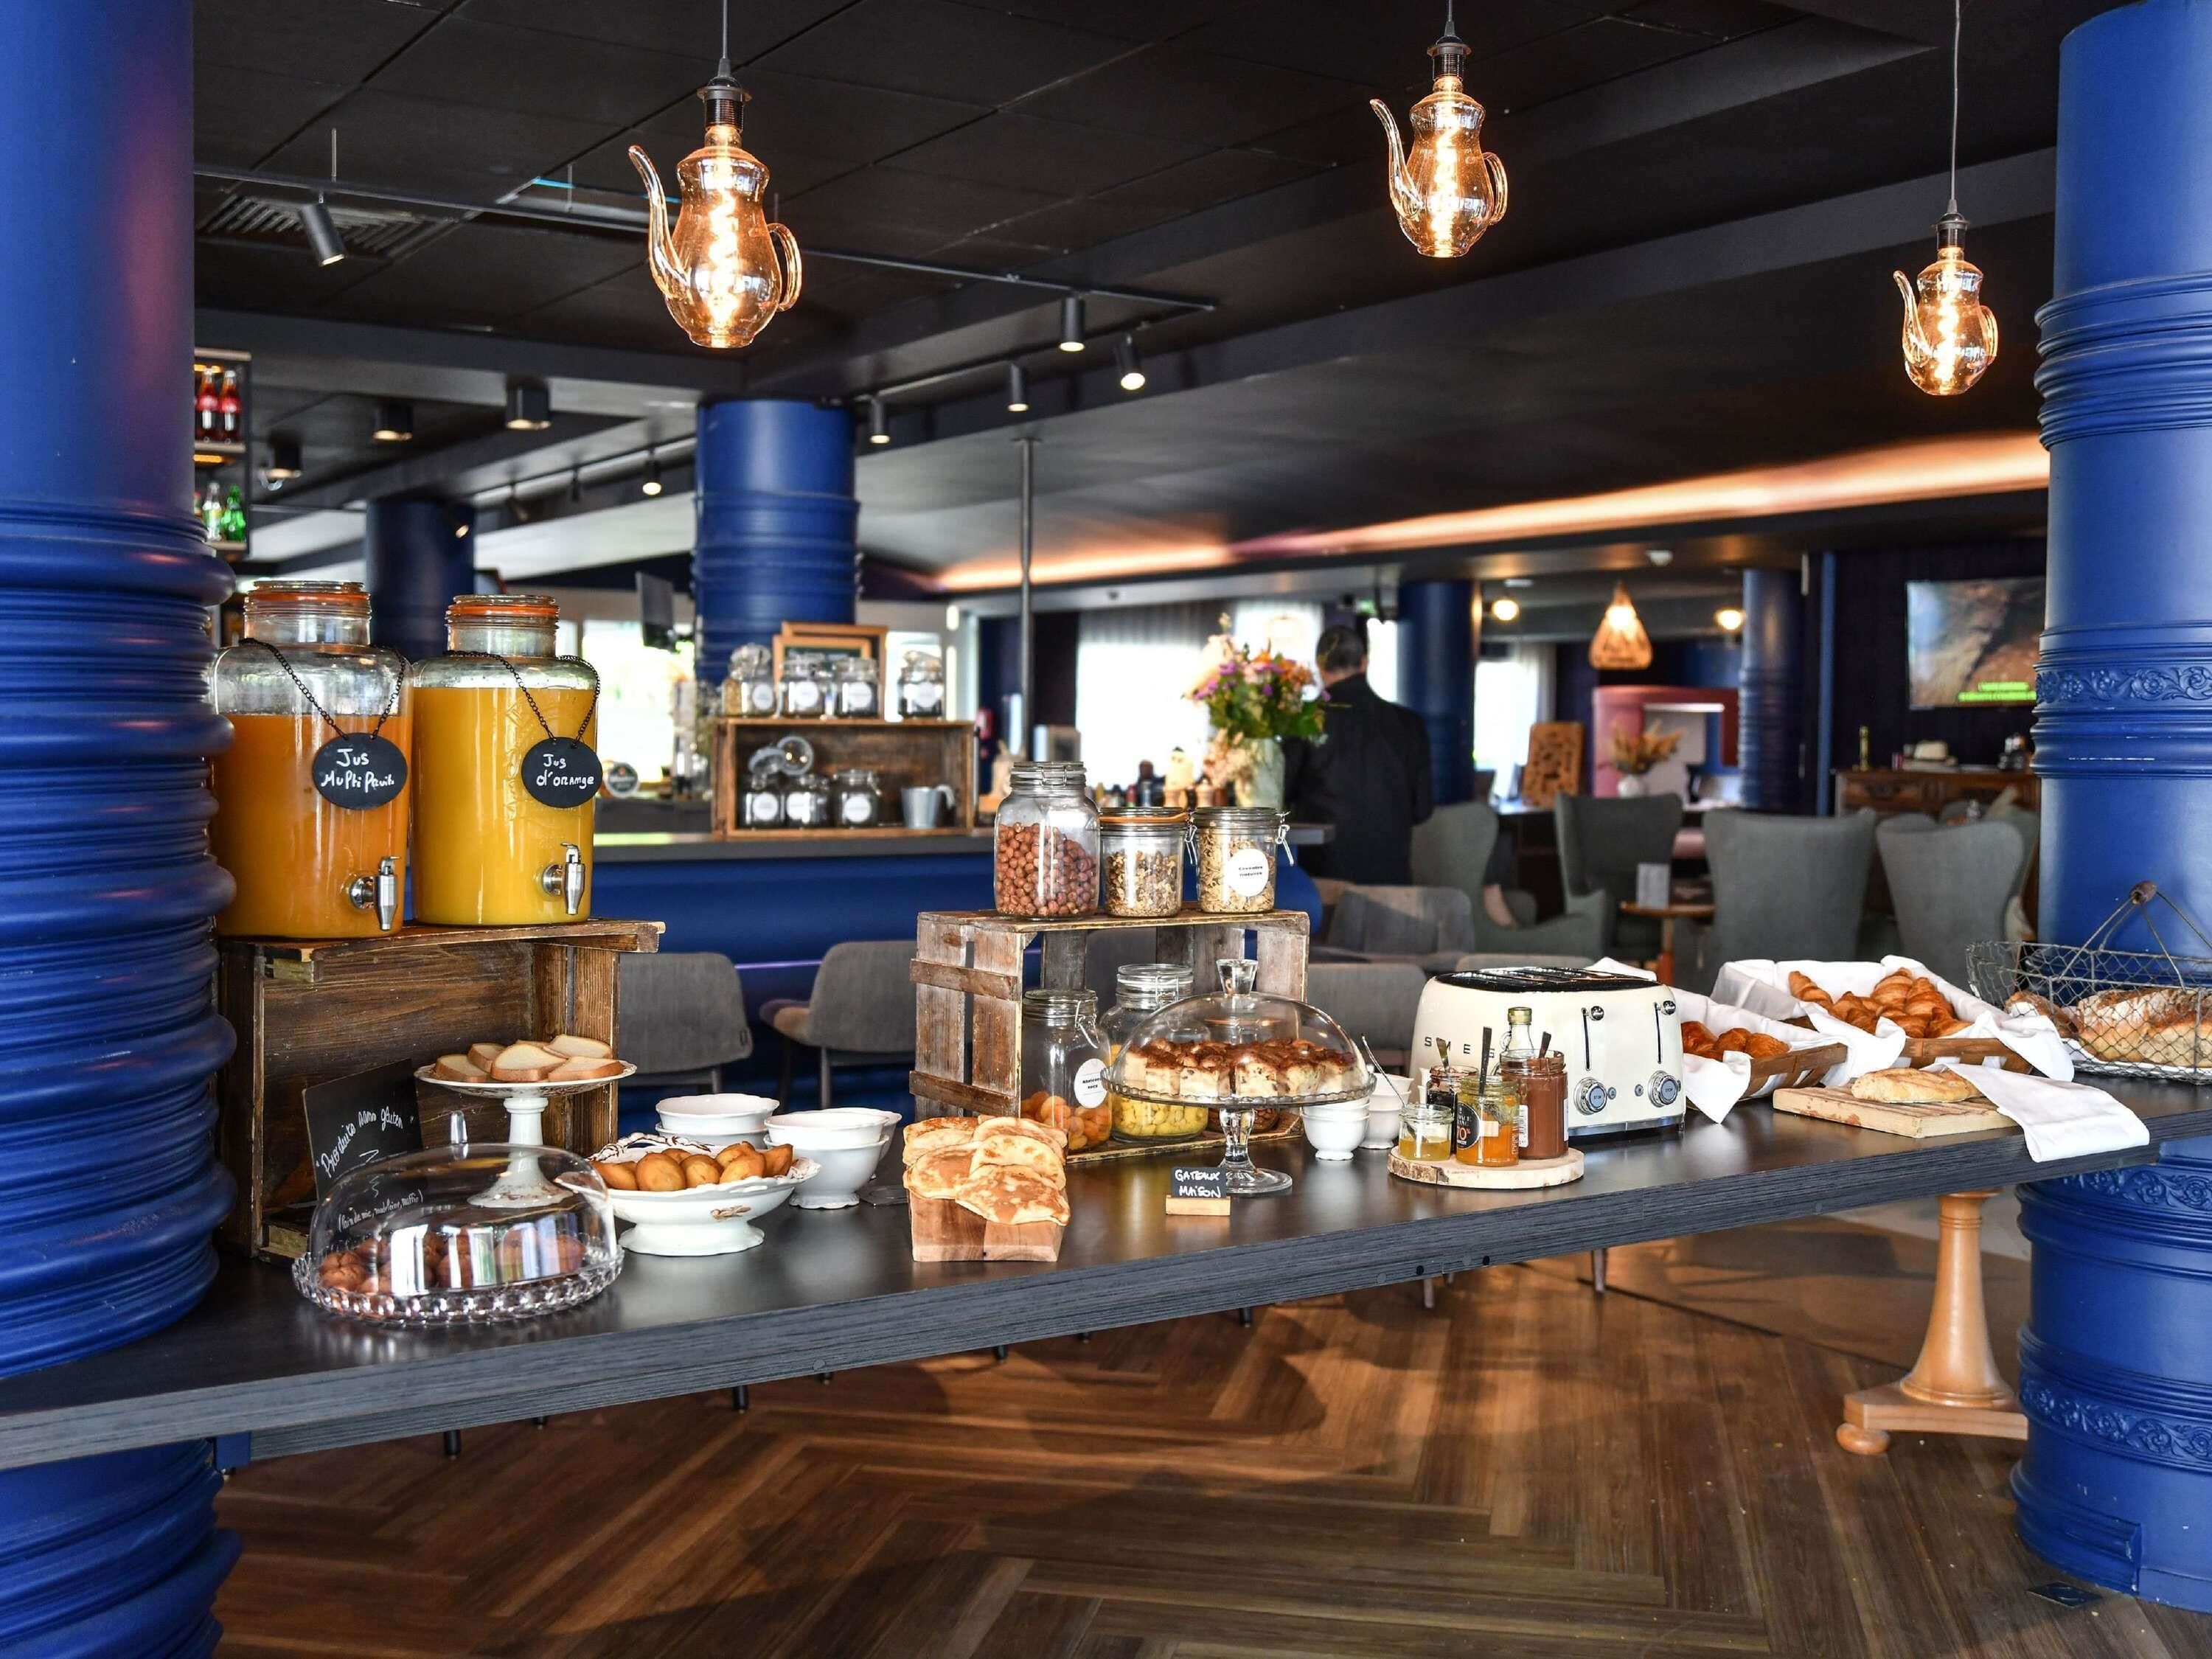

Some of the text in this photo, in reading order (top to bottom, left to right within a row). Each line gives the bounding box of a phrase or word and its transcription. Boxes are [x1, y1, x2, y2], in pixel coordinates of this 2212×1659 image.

[336, 748, 369, 768] Jus
[543, 754, 566, 768] Jus
[1424, 1036, 1495, 1059] SEG
